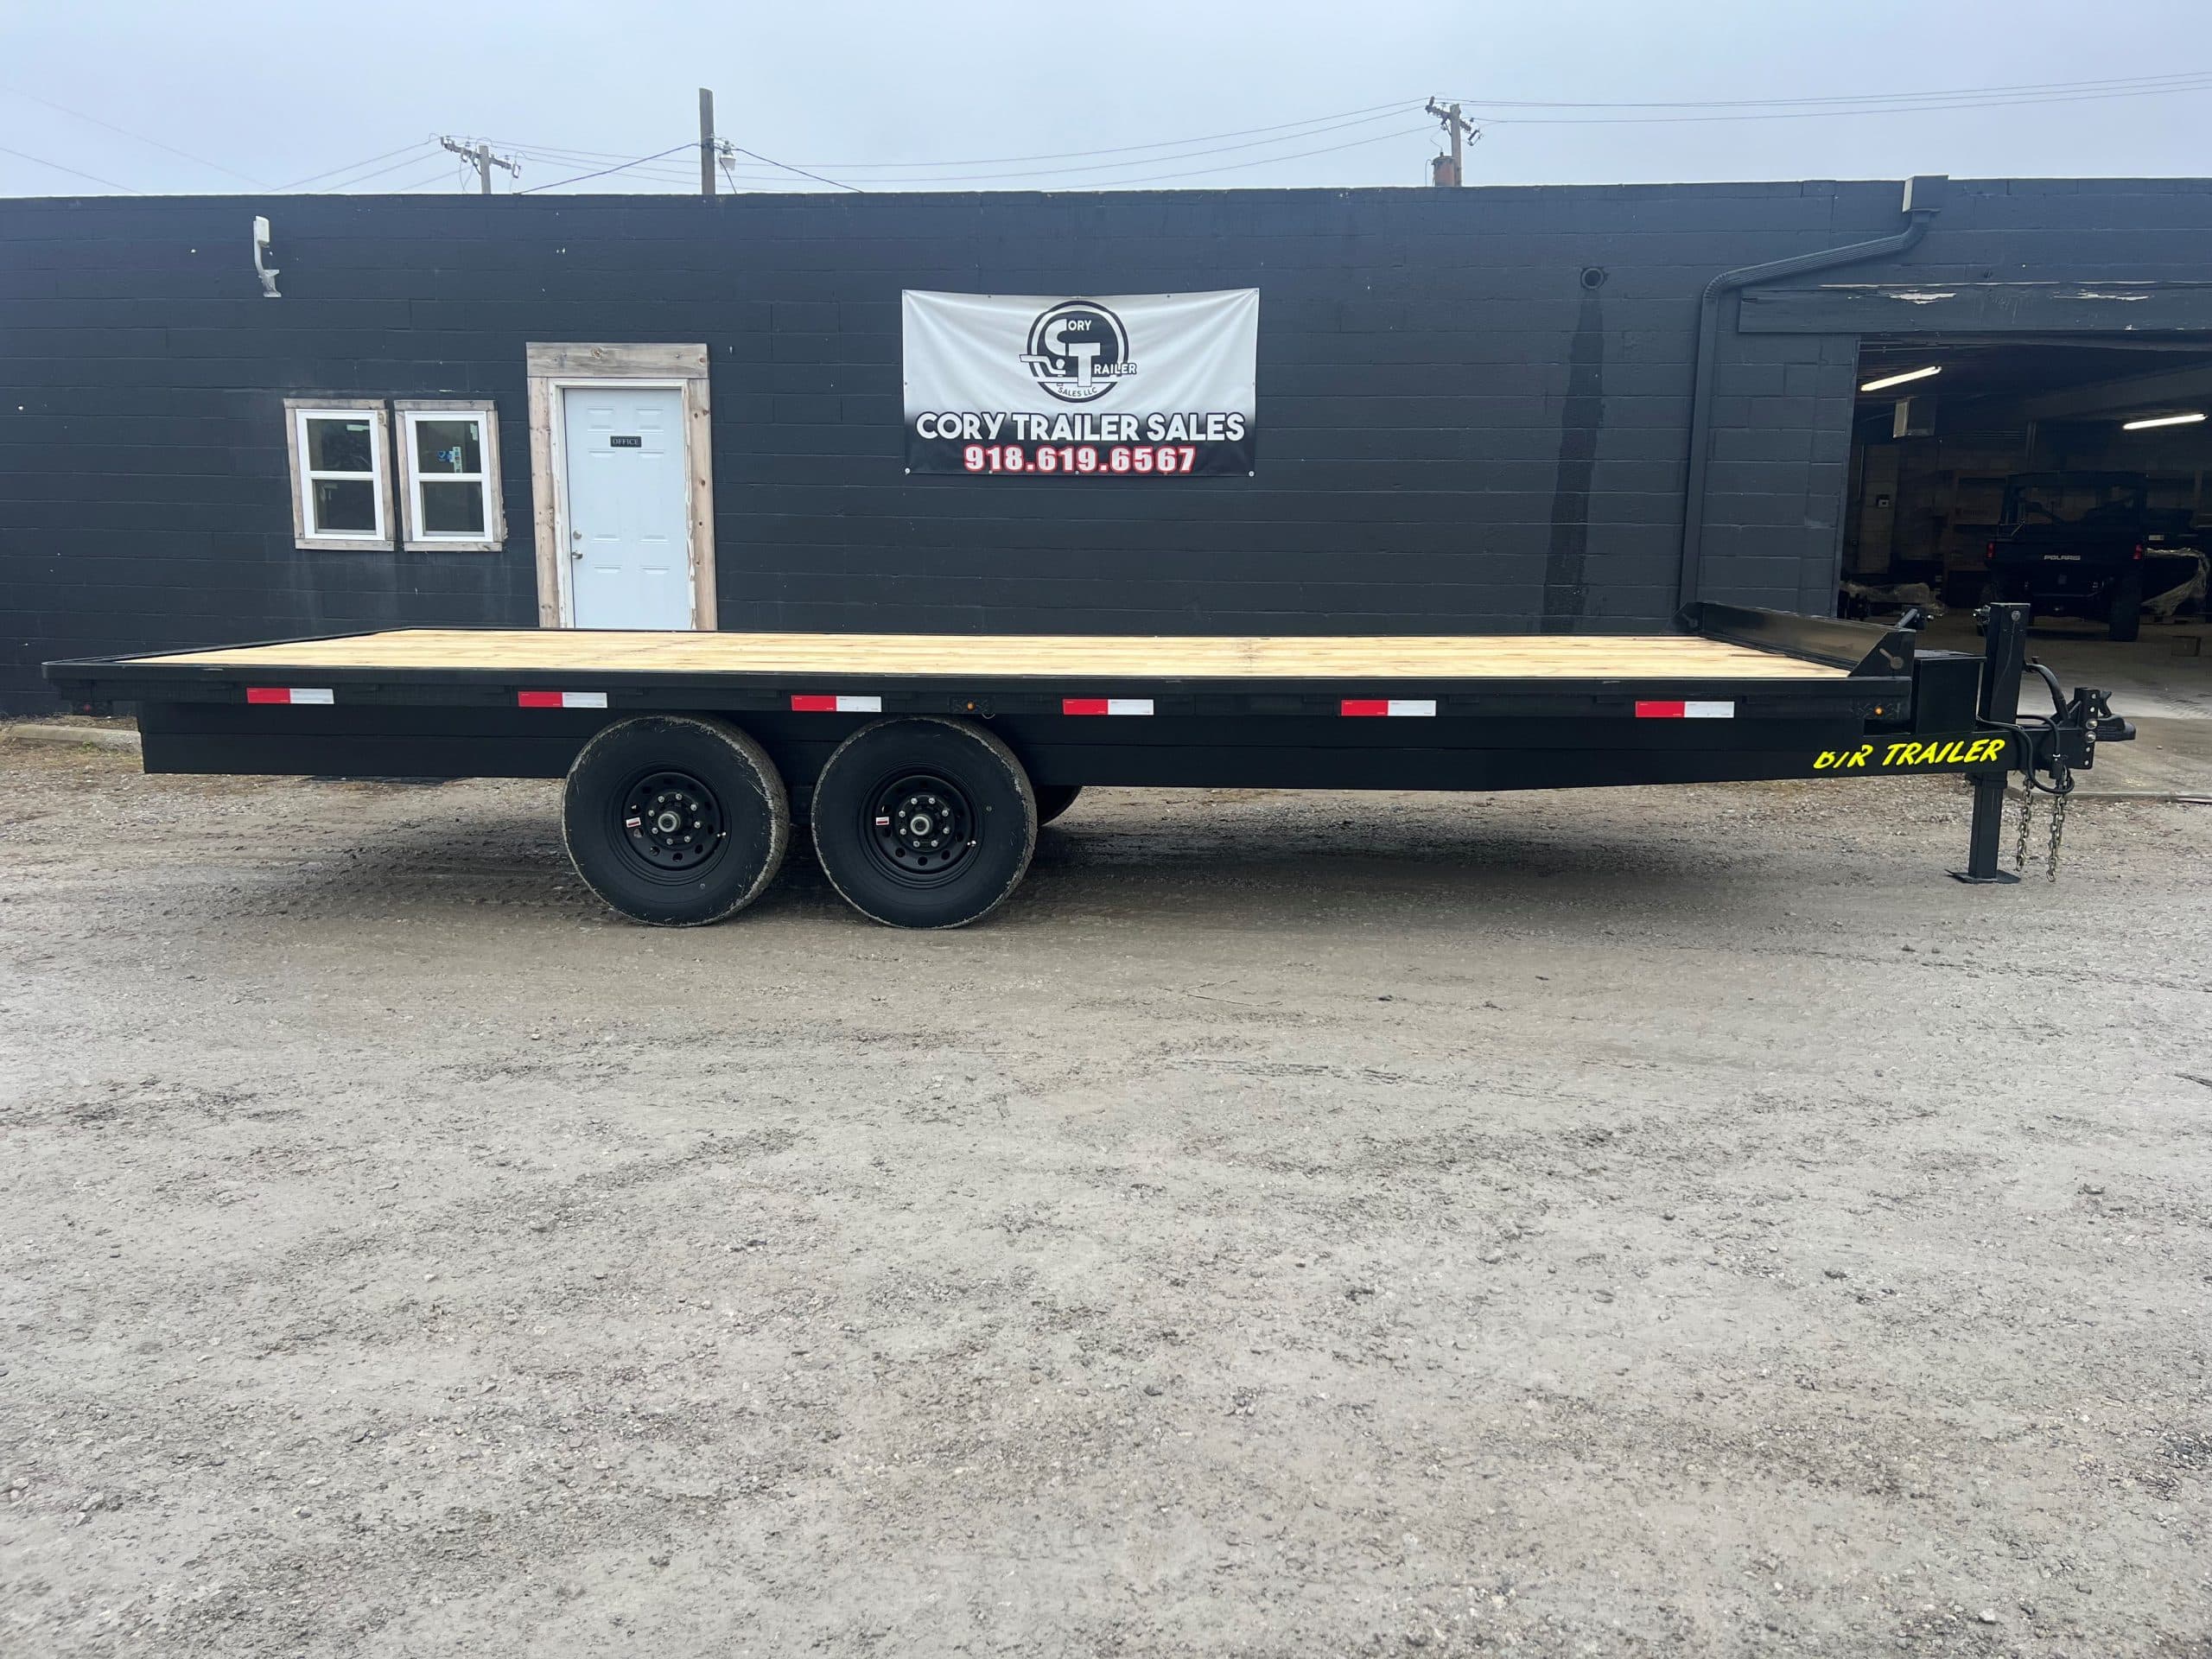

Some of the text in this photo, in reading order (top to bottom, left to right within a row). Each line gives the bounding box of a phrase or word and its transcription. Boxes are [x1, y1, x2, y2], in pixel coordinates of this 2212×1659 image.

[1058, 386, 1098, 397] SALES LLC
[916, 411, 1246, 442] CORY TRAILER SALES
[963, 444, 1197, 474] 918.619.6567
[1882, 739, 2005, 766] TRAILER
